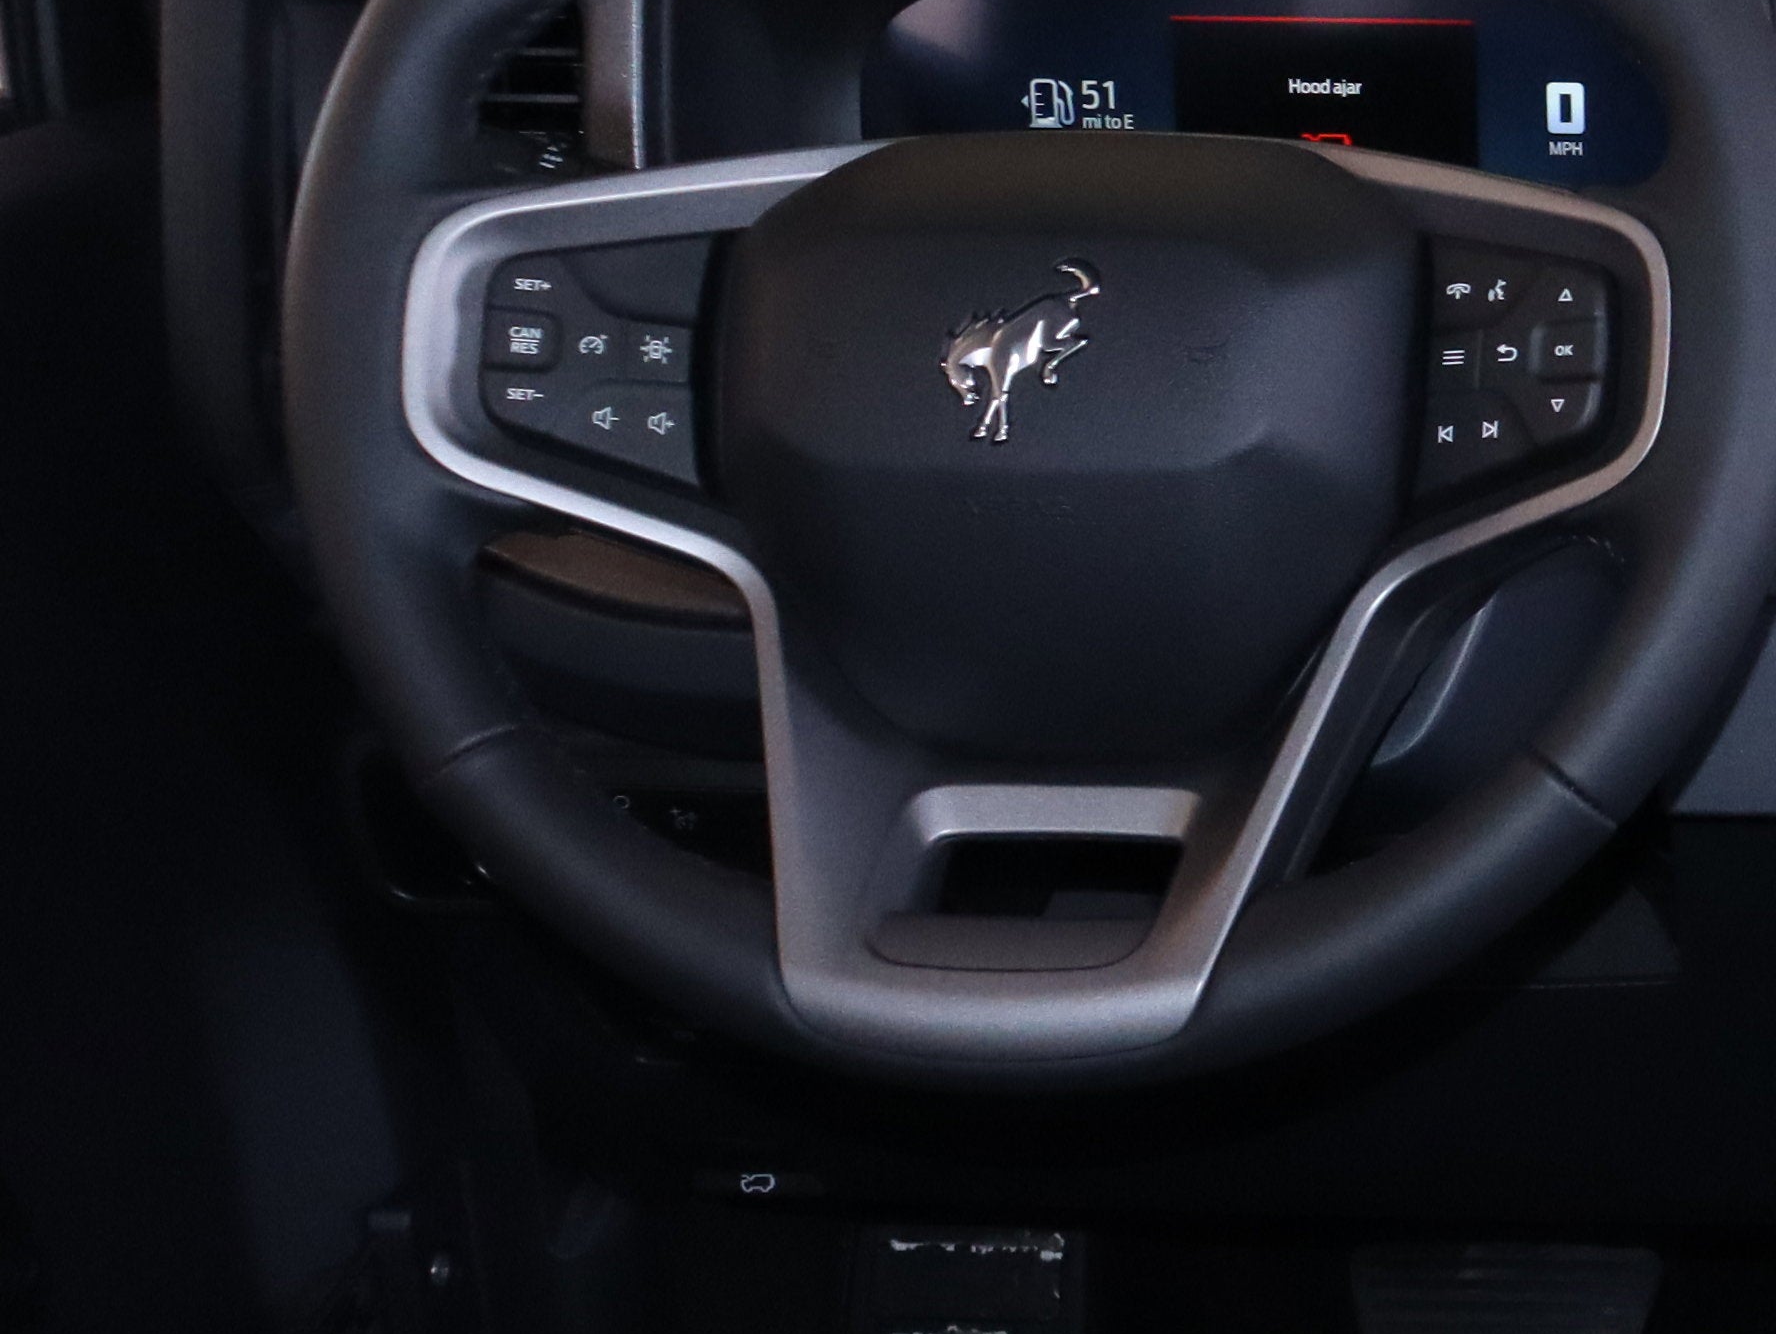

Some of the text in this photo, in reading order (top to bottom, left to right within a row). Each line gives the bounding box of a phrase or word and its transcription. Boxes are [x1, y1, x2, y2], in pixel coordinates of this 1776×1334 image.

[1081, 80, 1116, 109] 51
[1288, 78, 1362, 97] Hood ajar
[1546, 82, 1585, 134] 0
[1082, 113, 1135, 129] mi to E
[1549, 142, 1583, 156] MPH
[514, 278, 551, 291] SET+
[509, 327, 543, 339] CAN
[510, 342, 539, 354] RES
[1555, 345, 1573, 356] OK
